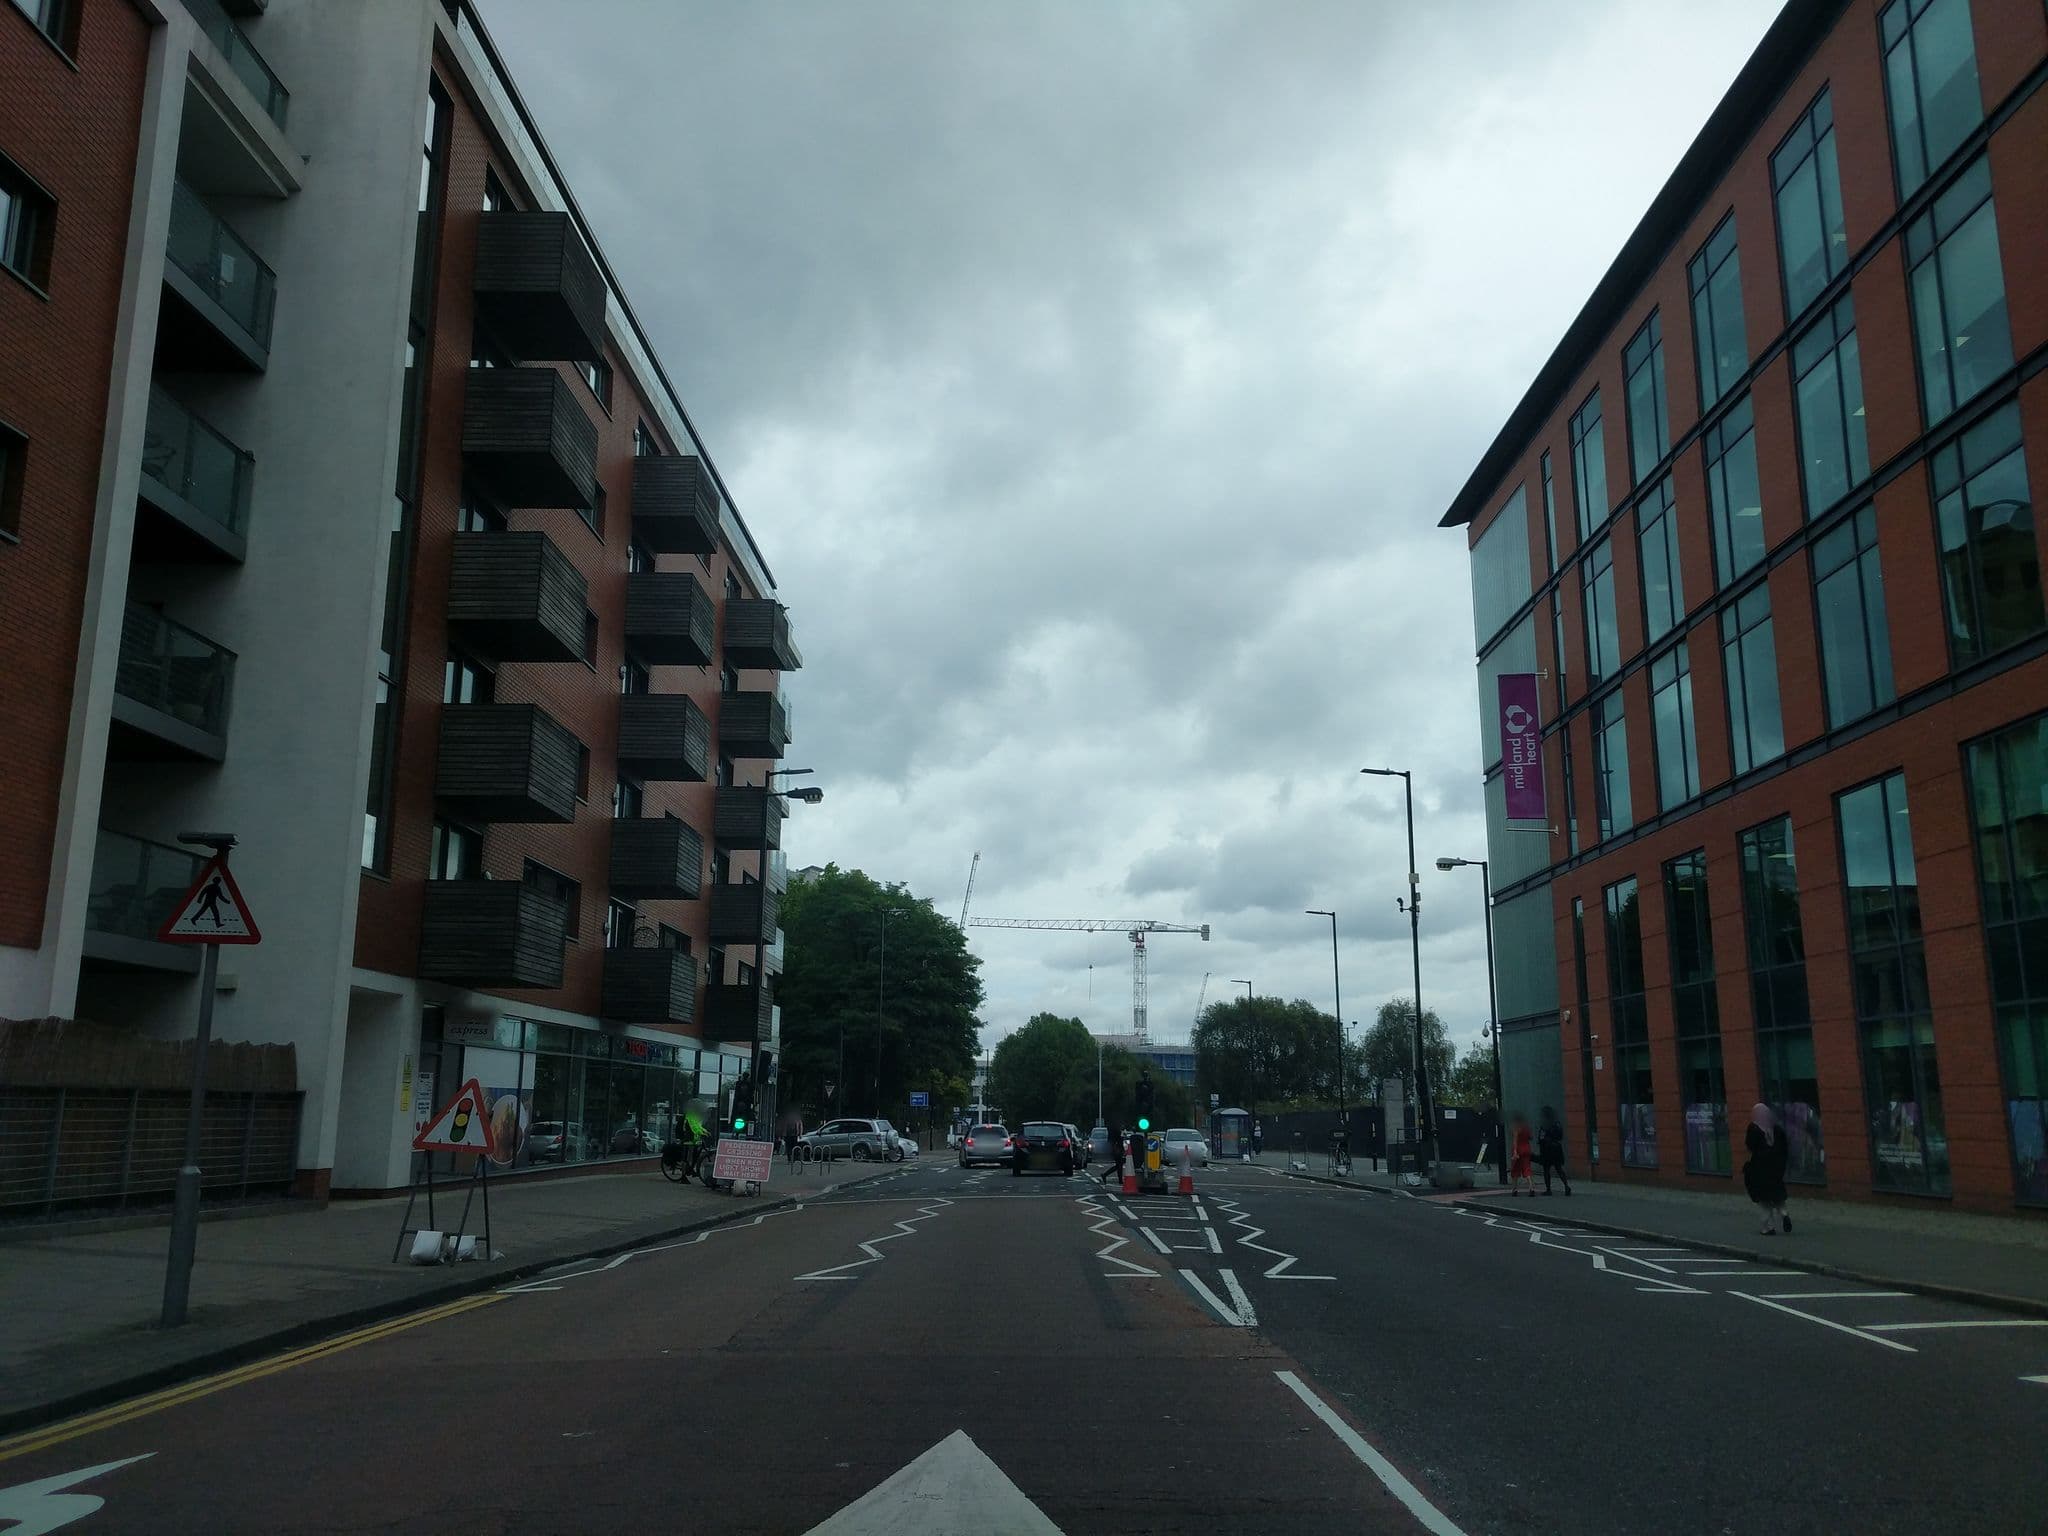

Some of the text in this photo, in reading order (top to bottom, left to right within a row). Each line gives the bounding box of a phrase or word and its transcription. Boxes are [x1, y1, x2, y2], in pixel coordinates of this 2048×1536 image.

[1506, 738, 1525, 789] midland
[1523, 732, 1537, 765] heart
[726, 1149, 763, 1157] CROSSING
